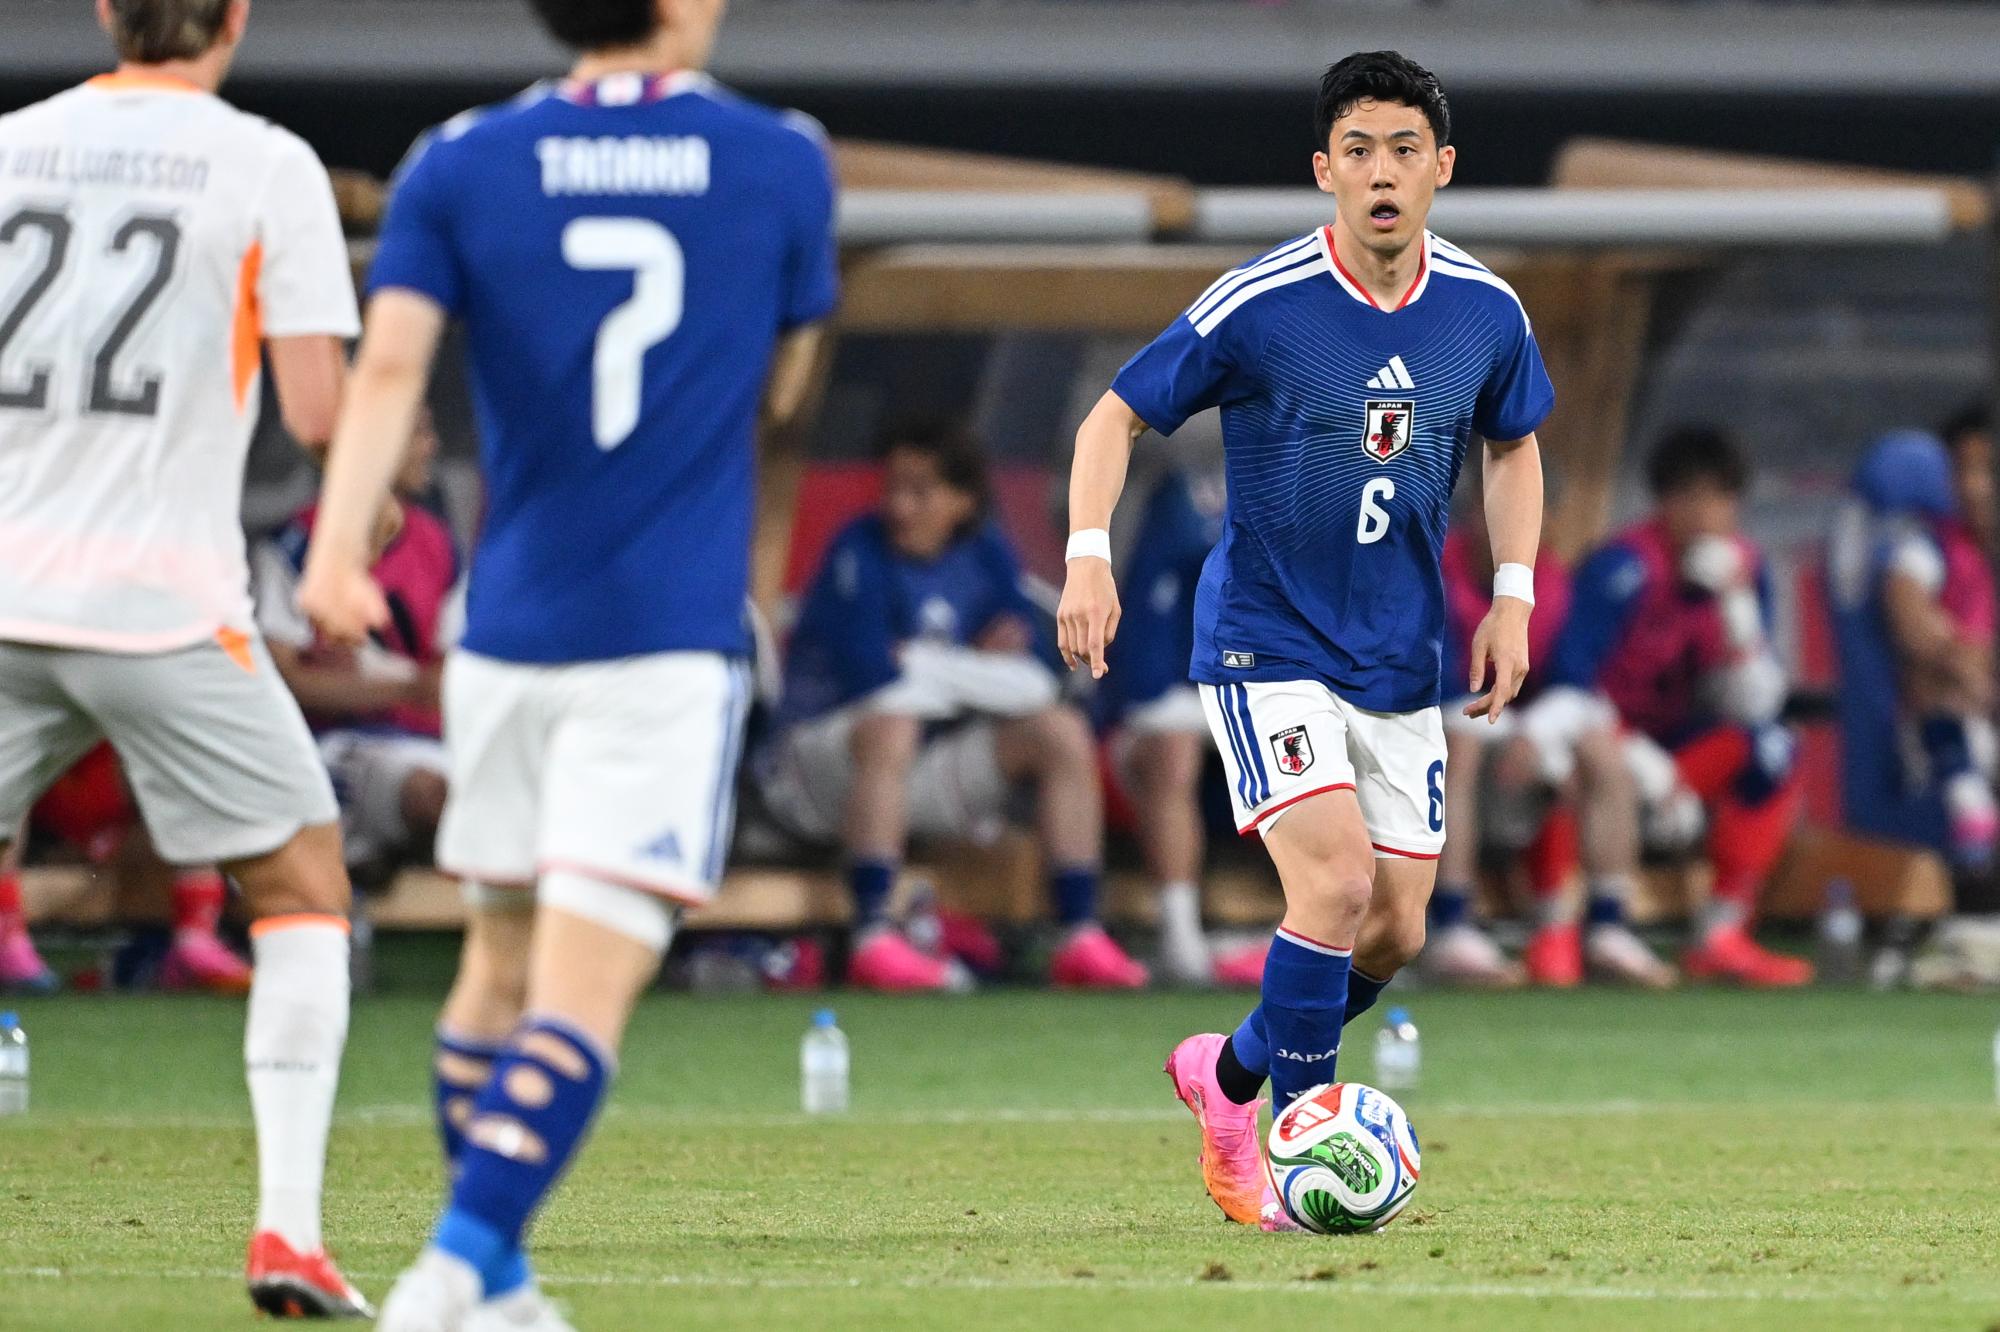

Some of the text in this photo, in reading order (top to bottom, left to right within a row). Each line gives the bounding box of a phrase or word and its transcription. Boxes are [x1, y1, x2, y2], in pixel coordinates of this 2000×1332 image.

[0, 209, 181, 416] 22
[561, 216, 685, 451] 7
[1374, 441, 1395, 452] JFA
[1357, 477, 1396, 545] 6
[1427, 759, 1444, 833] 6
[1343, 1138, 1376, 1177] TRIONDA
